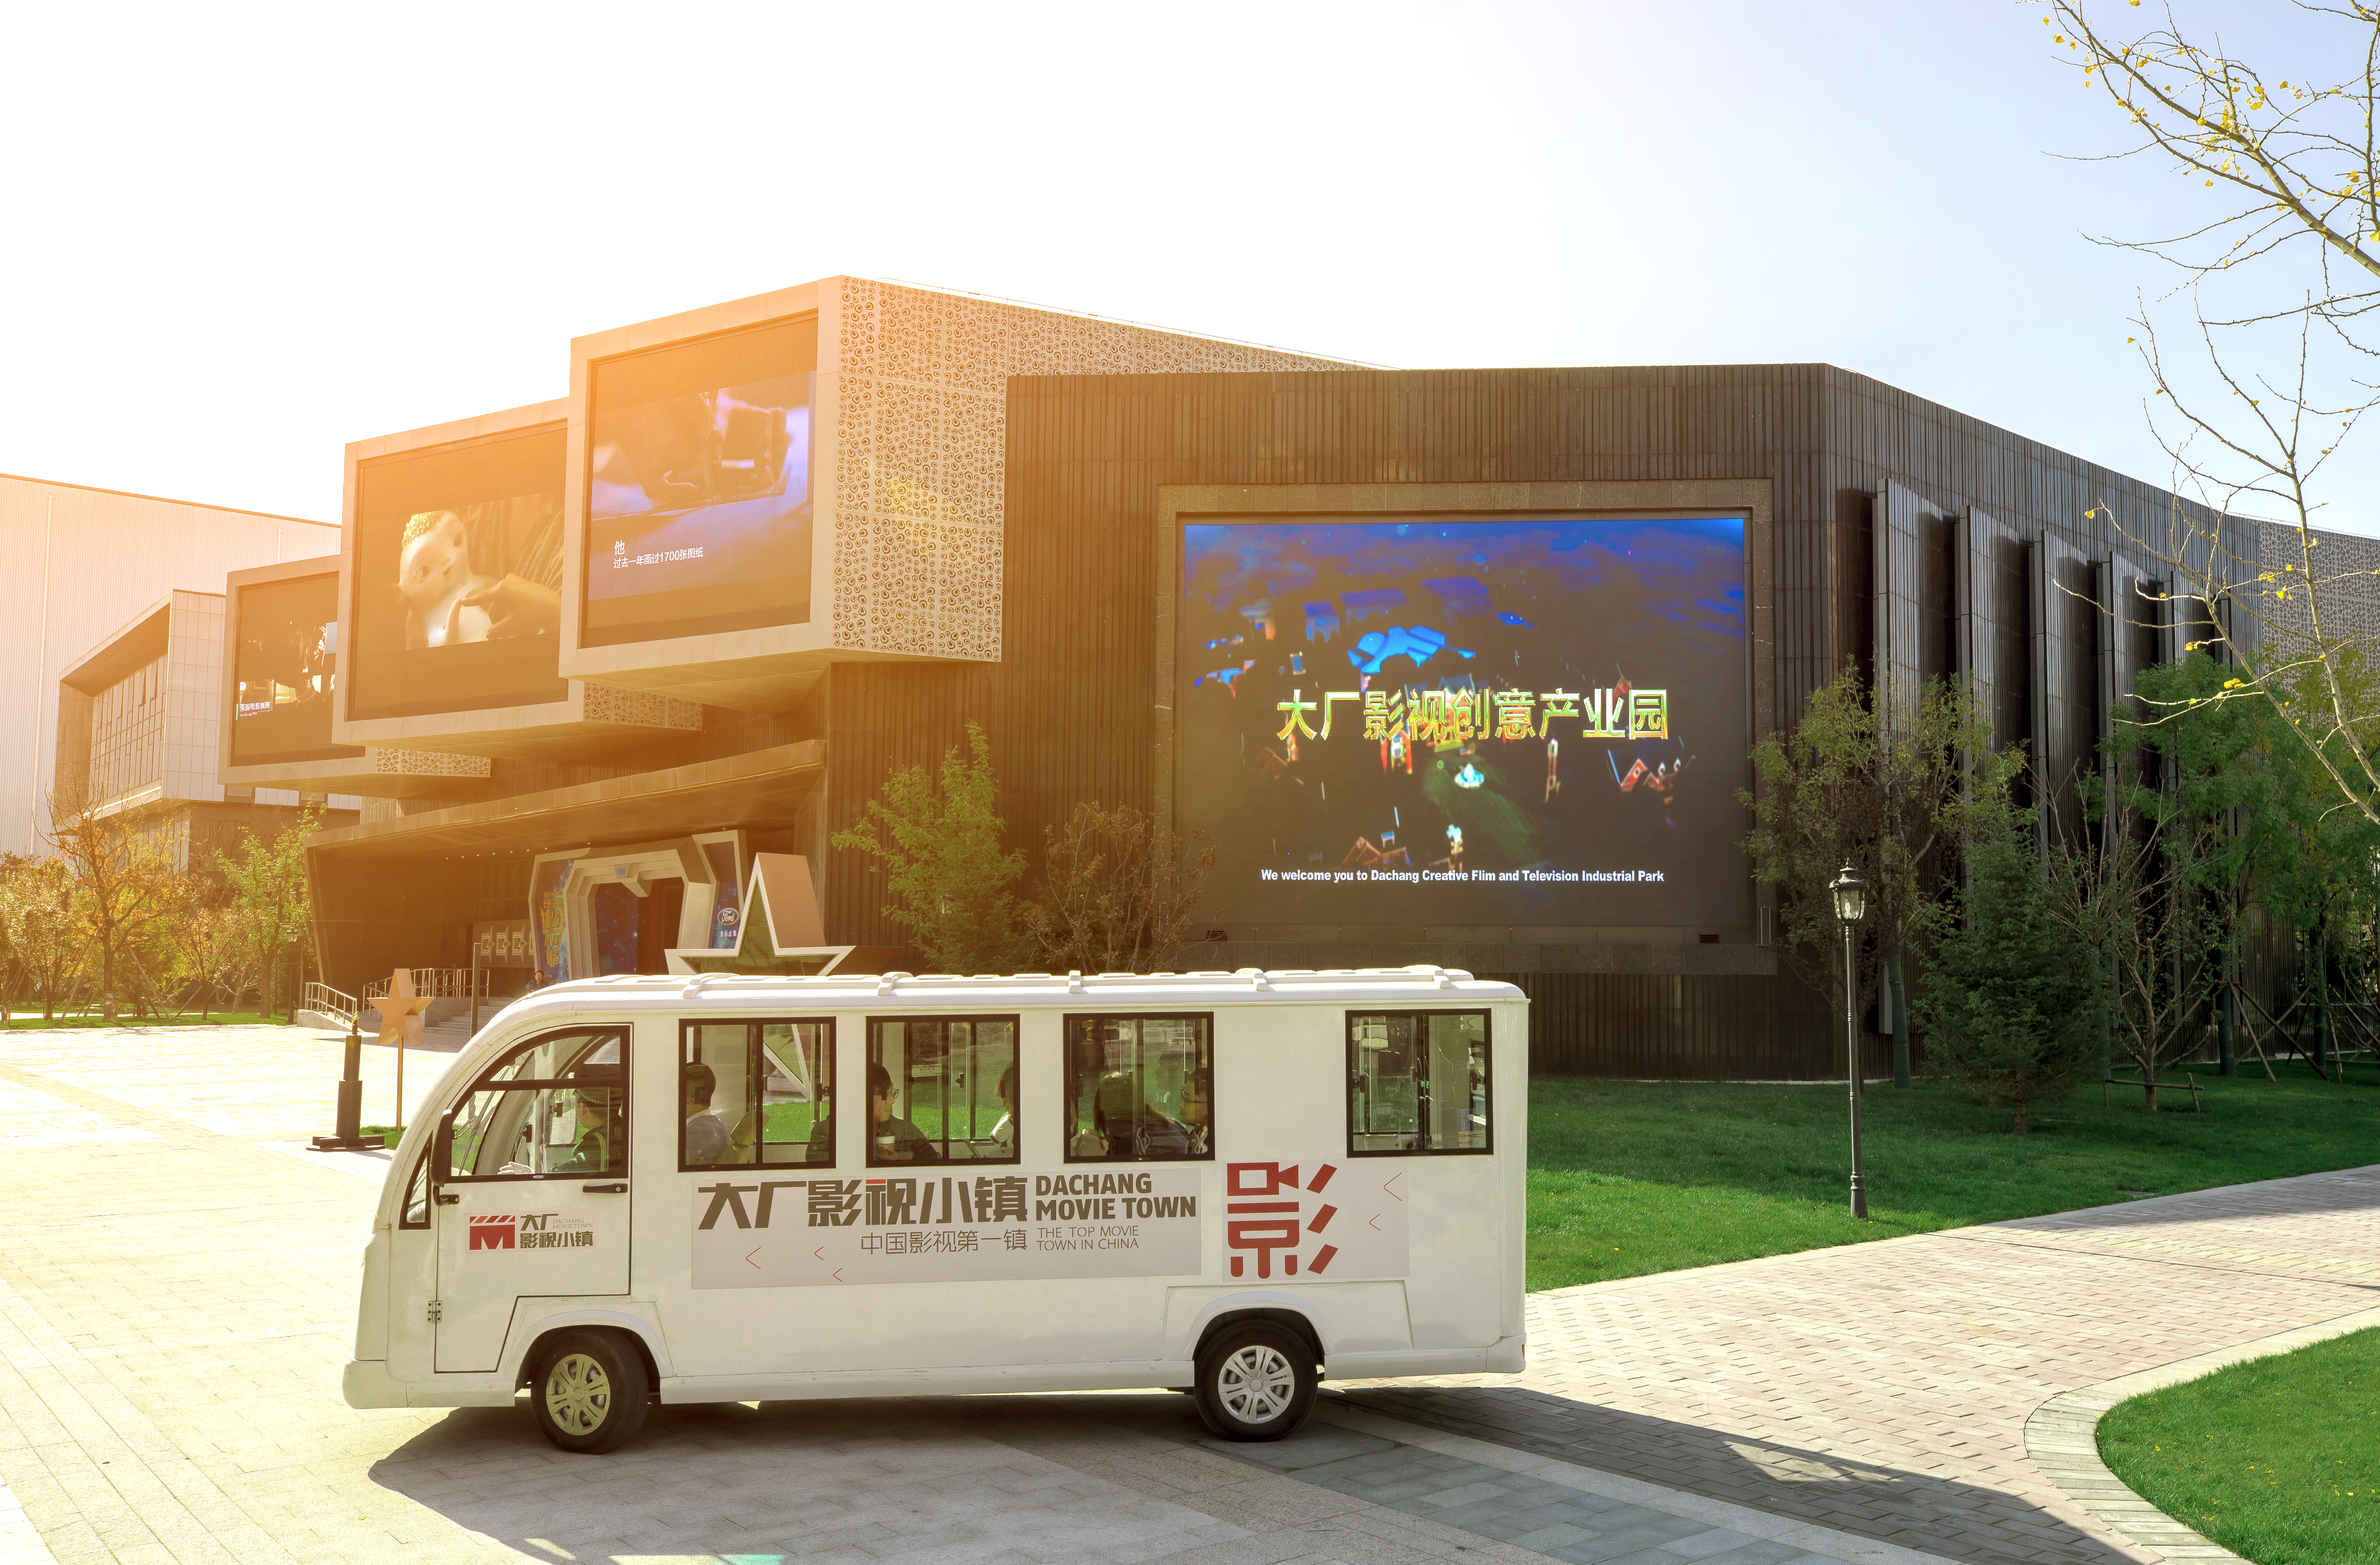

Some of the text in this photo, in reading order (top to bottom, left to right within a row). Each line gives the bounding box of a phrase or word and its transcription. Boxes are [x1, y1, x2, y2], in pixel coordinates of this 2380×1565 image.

[614, 540, 625, 556] 他
[613, 547, 704, 569] 过去一年画过1700张图纸
[1276, 688, 1668, 741] 大厂影视创意产业园
[1261, 869, 1664, 883] We welcome you to Dachang Creative Flim and Television Industrial Park
[721, 910, 735, 922] Ford
[1036, 1173, 1152, 1196] DACHANG
[698, 1176, 1028, 1230] 大厂影视小镇
[1036, 1196, 1196, 1221] MOVIE TOWN
[520, 1214, 558, 1231] 大厂
[1037, 1225, 1139, 1238] THE TOP MOVIE
[520, 1231, 593, 1249] 影视小镇
[861, 1228, 1028, 1255] 中国影视第一镇
[1036, 1238, 1139, 1251] TOWN IN CHINA
